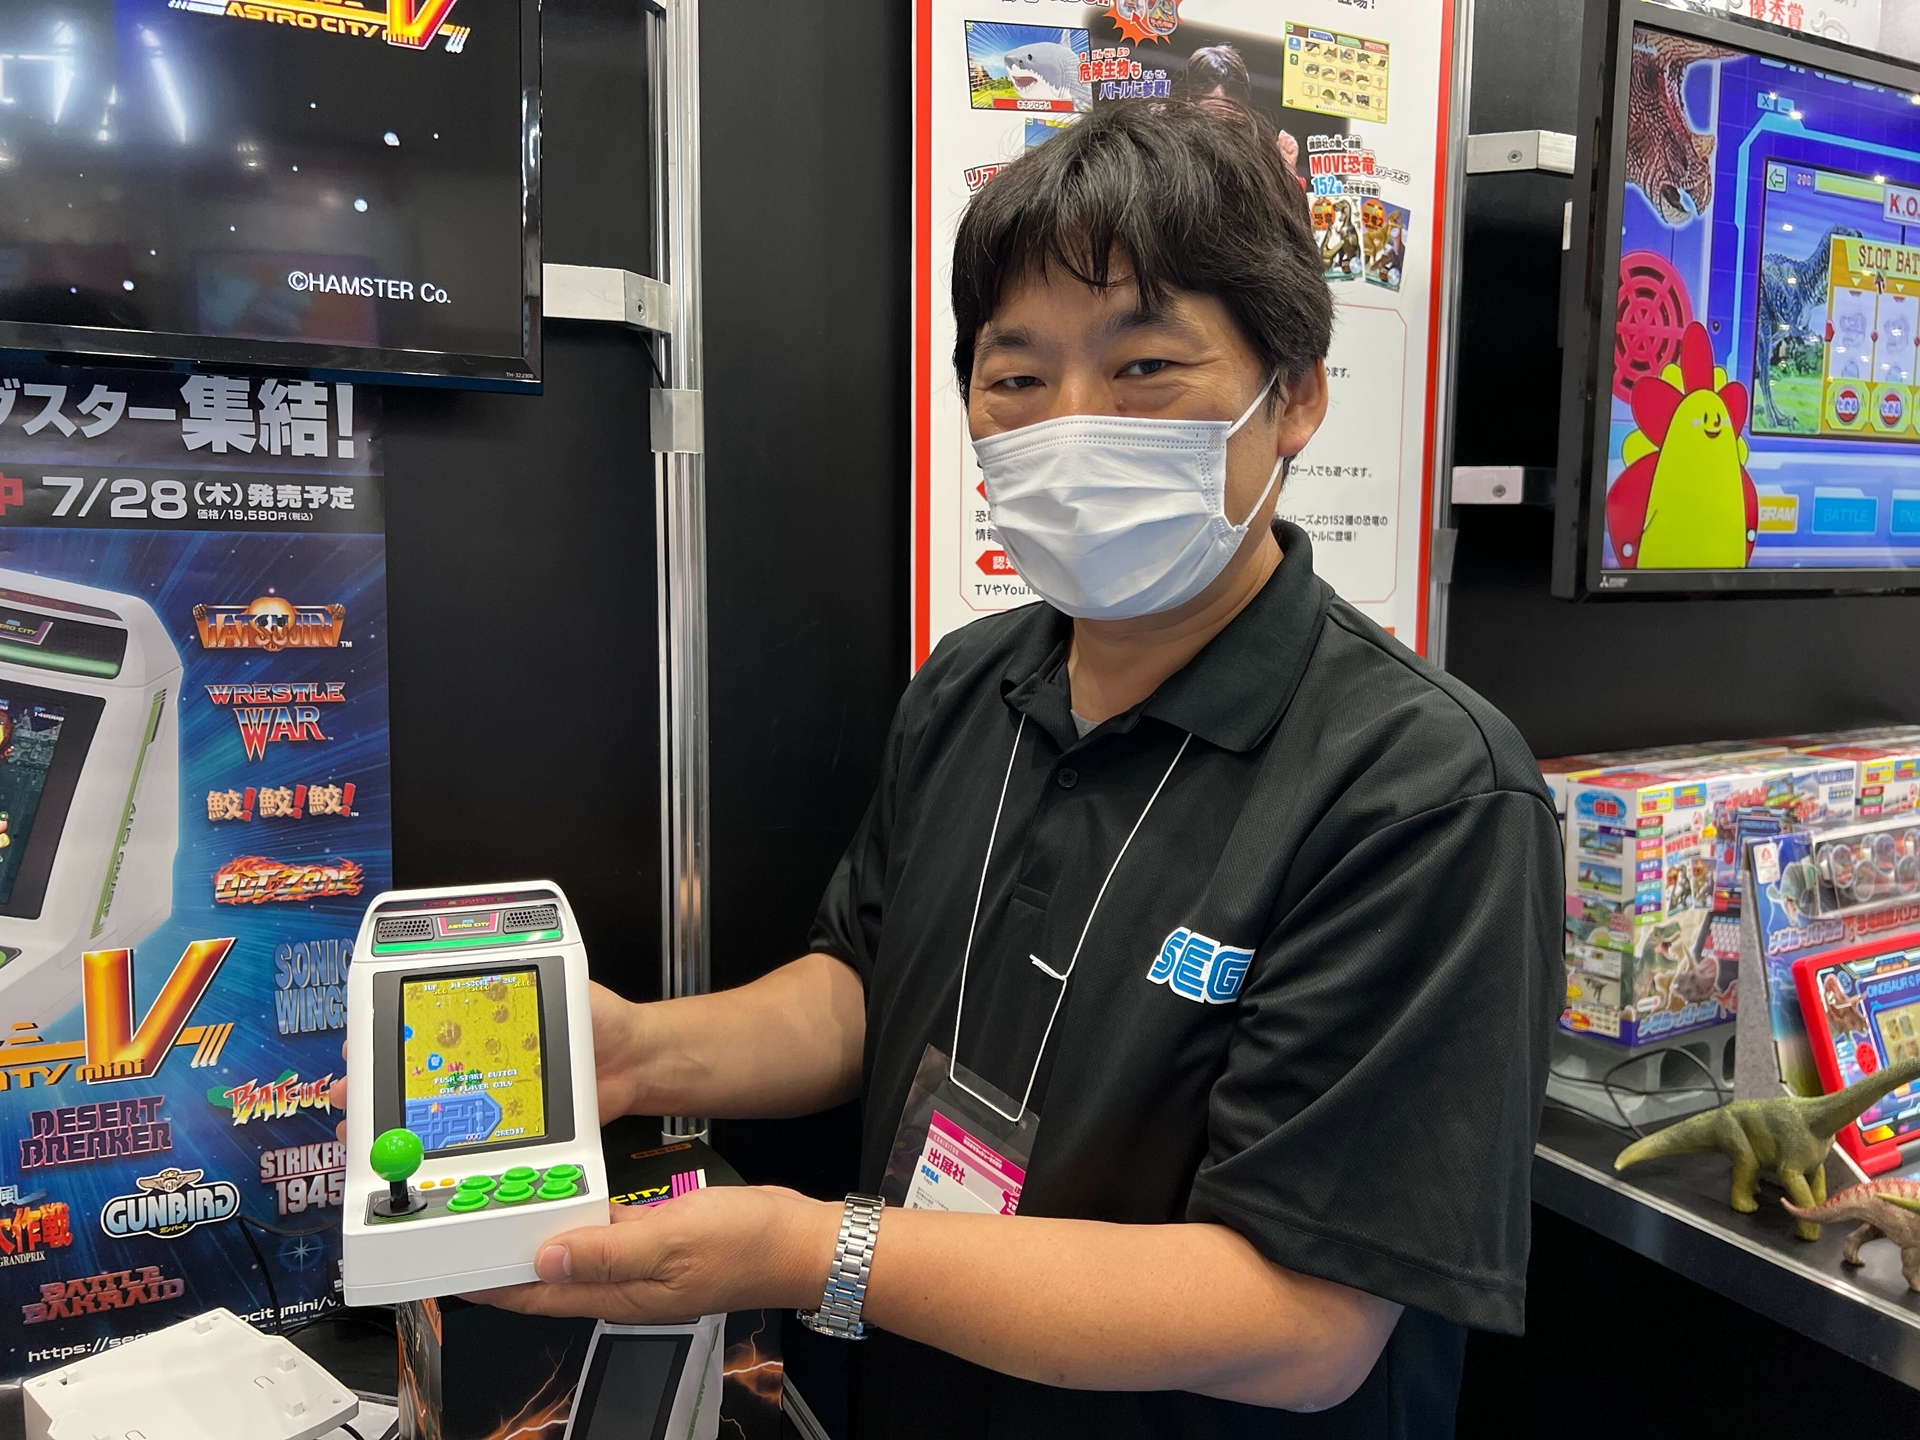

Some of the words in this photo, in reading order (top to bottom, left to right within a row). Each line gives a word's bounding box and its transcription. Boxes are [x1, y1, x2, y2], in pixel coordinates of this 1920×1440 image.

[225, 2, 318, 28] ASTRO
[321, 18, 379, 38] CITY
[1749, 0, 1804, 30] 優秀賞
[1078, 58, 1143, 83] 危険生物も
[1099, 79, 1171, 100] バトルに参戦!
[1858, 244, 1891, 271] SLOT
[288, 269, 414, 302] ©HAMSTER
[420, 281, 452, 305] Co.
[197, 508, 313, 522] 価格/19,580円(税込)
[1823, 508, 1869, 524] BATTLE
[203, 606, 340, 650] TATSUJIN
[204, 682, 346, 705] WRESTLE
[233, 706, 327, 762] WAR
[474, 920, 490, 928] CITY
[273, 937, 356, 990] SONIC
[82, 937, 236, 1086] V
[75, 1059, 145, 1082] mini
[30, 1094, 165, 1140] DESERT
[223, 1073, 340, 1126] BATSUG
[20, 1122, 172, 1168] BREAKER
[920, 1164, 940, 1185] SEGA
[927, 1147, 966, 1186] 出展社
[104, 1188, 236, 1234] GUNBIRD
[275, 1171, 346, 1216] 1945
[609, 1184, 670, 1205] CITY
[22, 1278, 185, 1325] BAKRAID
[40, 1265, 164, 1302] BATTLE
